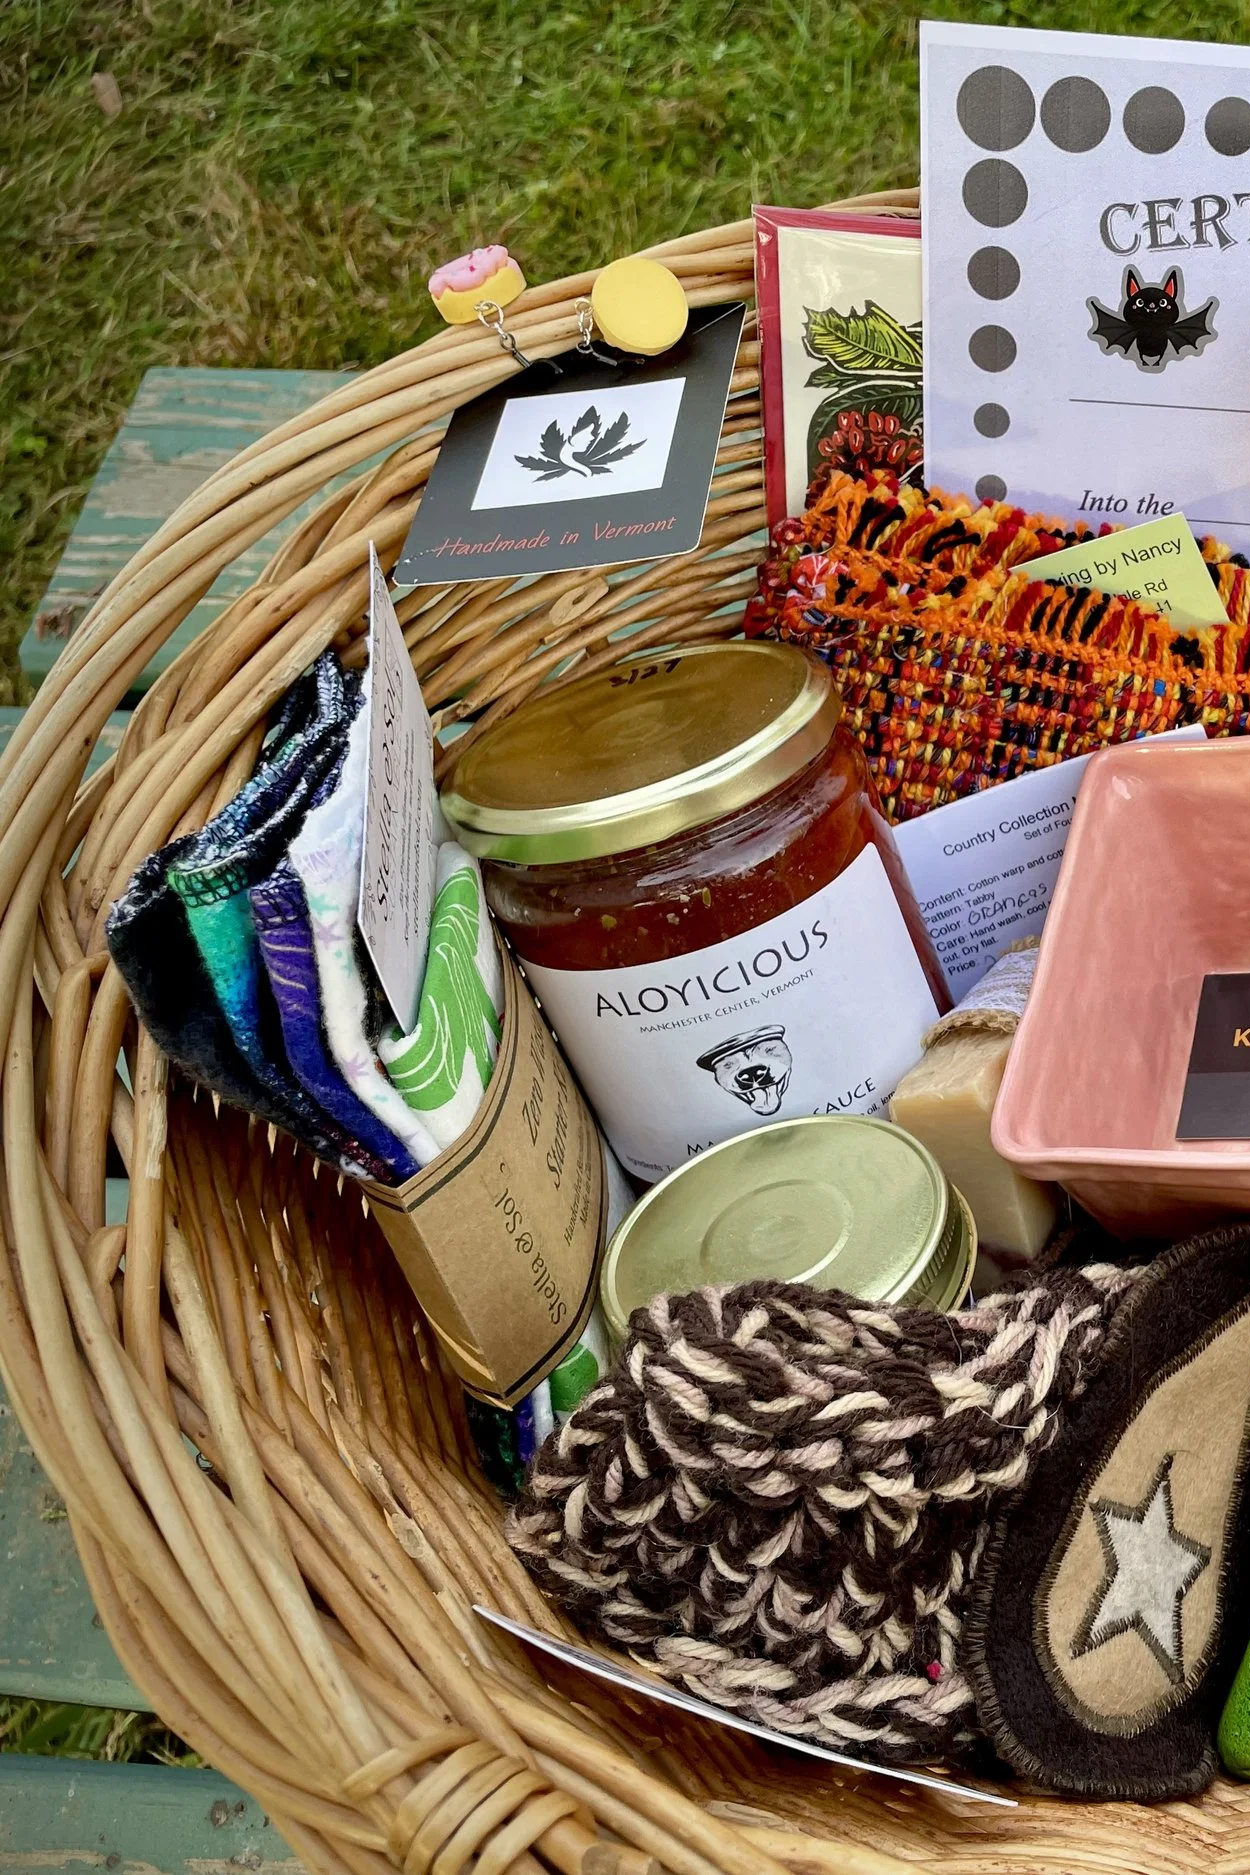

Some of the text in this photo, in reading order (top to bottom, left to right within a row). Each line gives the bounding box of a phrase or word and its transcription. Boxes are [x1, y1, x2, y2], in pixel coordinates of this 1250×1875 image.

[1078, 489, 1175, 515] Into the
[433, 515, 678, 559] Handmade in Vermont
[1094, 536, 1183, 576] by Nancy
[1144, 578, 1169, 596] Rd
[942, 801, 1071, 857] Country Collection
[1023, 826, 1042, 841] Set
[1042, 823, 1054, 835] of
[967, 874, 1001, 893] Cotton
[1001, 864, 1026, 885] warp
[1027, 856, 1045, 871] and
[965, 891, 996, 909] Tabby
[969, 922, 998, 940] Hand
[1026, 901, 1047, 917] cool
[595, 919, 829, 1019] ALOYICIOUS
[961, 943, 980, 960] Dry
[639, 968, 816, 1035] MANCHESTER CENTER, VERMONT
[494, 1187, 523, 1233] Sol
[531, 1254, 568, 1327] Stella
